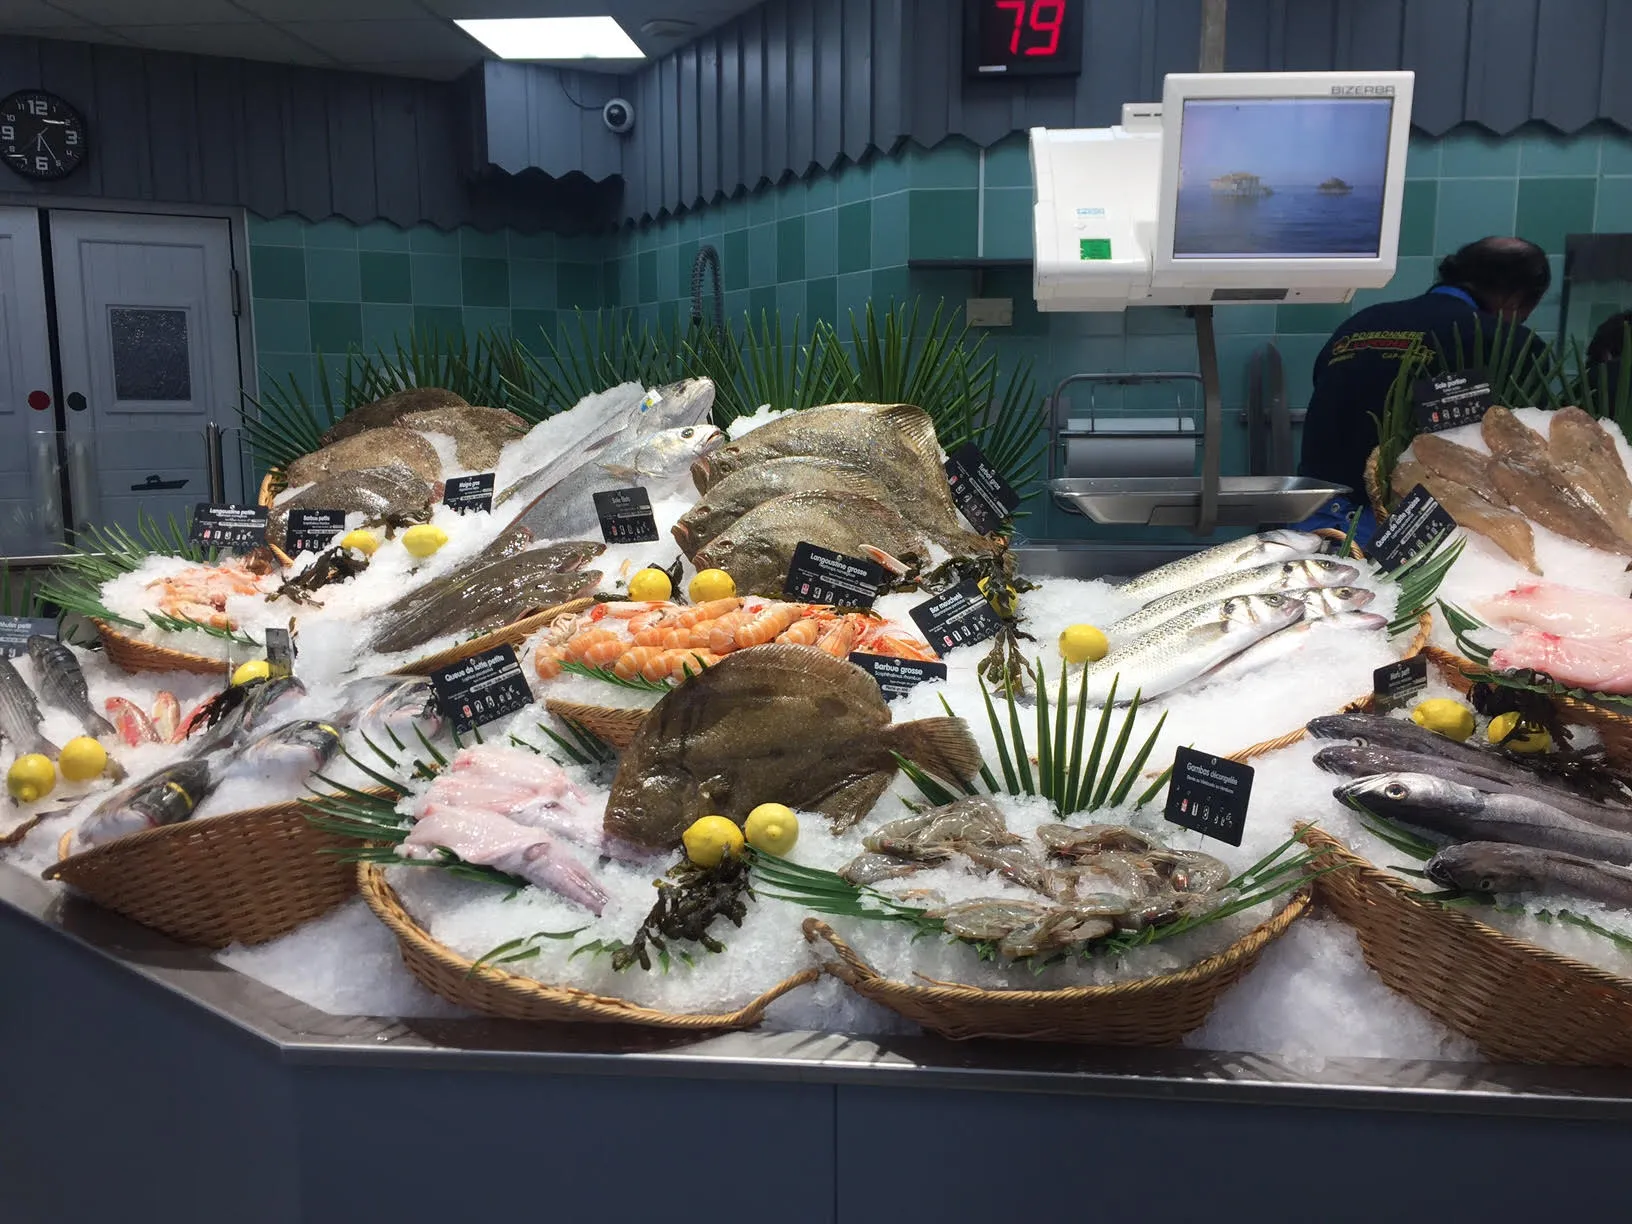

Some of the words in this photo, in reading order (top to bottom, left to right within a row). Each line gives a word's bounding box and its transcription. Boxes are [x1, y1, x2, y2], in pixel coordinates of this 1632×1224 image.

[996, 0, 1066, 56] 79
[1331, 85, 1396, 96] BIZERBA
[27, 99, 48, 116] 12
[1, 125, 15, 140] 9
[65, 130, 78, 145] 3
[35, 156, 49, 171] 6
[978, 463, 992, 479] Turbot
[1375, 529, 1391, 548] Queue
[810, 552, 847, 570] Langoustine
[847, 564, 868, 577] grosse
[444, 669, 465, 682] Queue
[465, 665, 474, 675] de
[474, 660, 488, 671] lotte
[488, 654, 505, 668] petite
[874, 661, 899, 672] Barbue
[900, 665, 923, 675] grosse
[1186, 762, 1210, 777] Gambas
